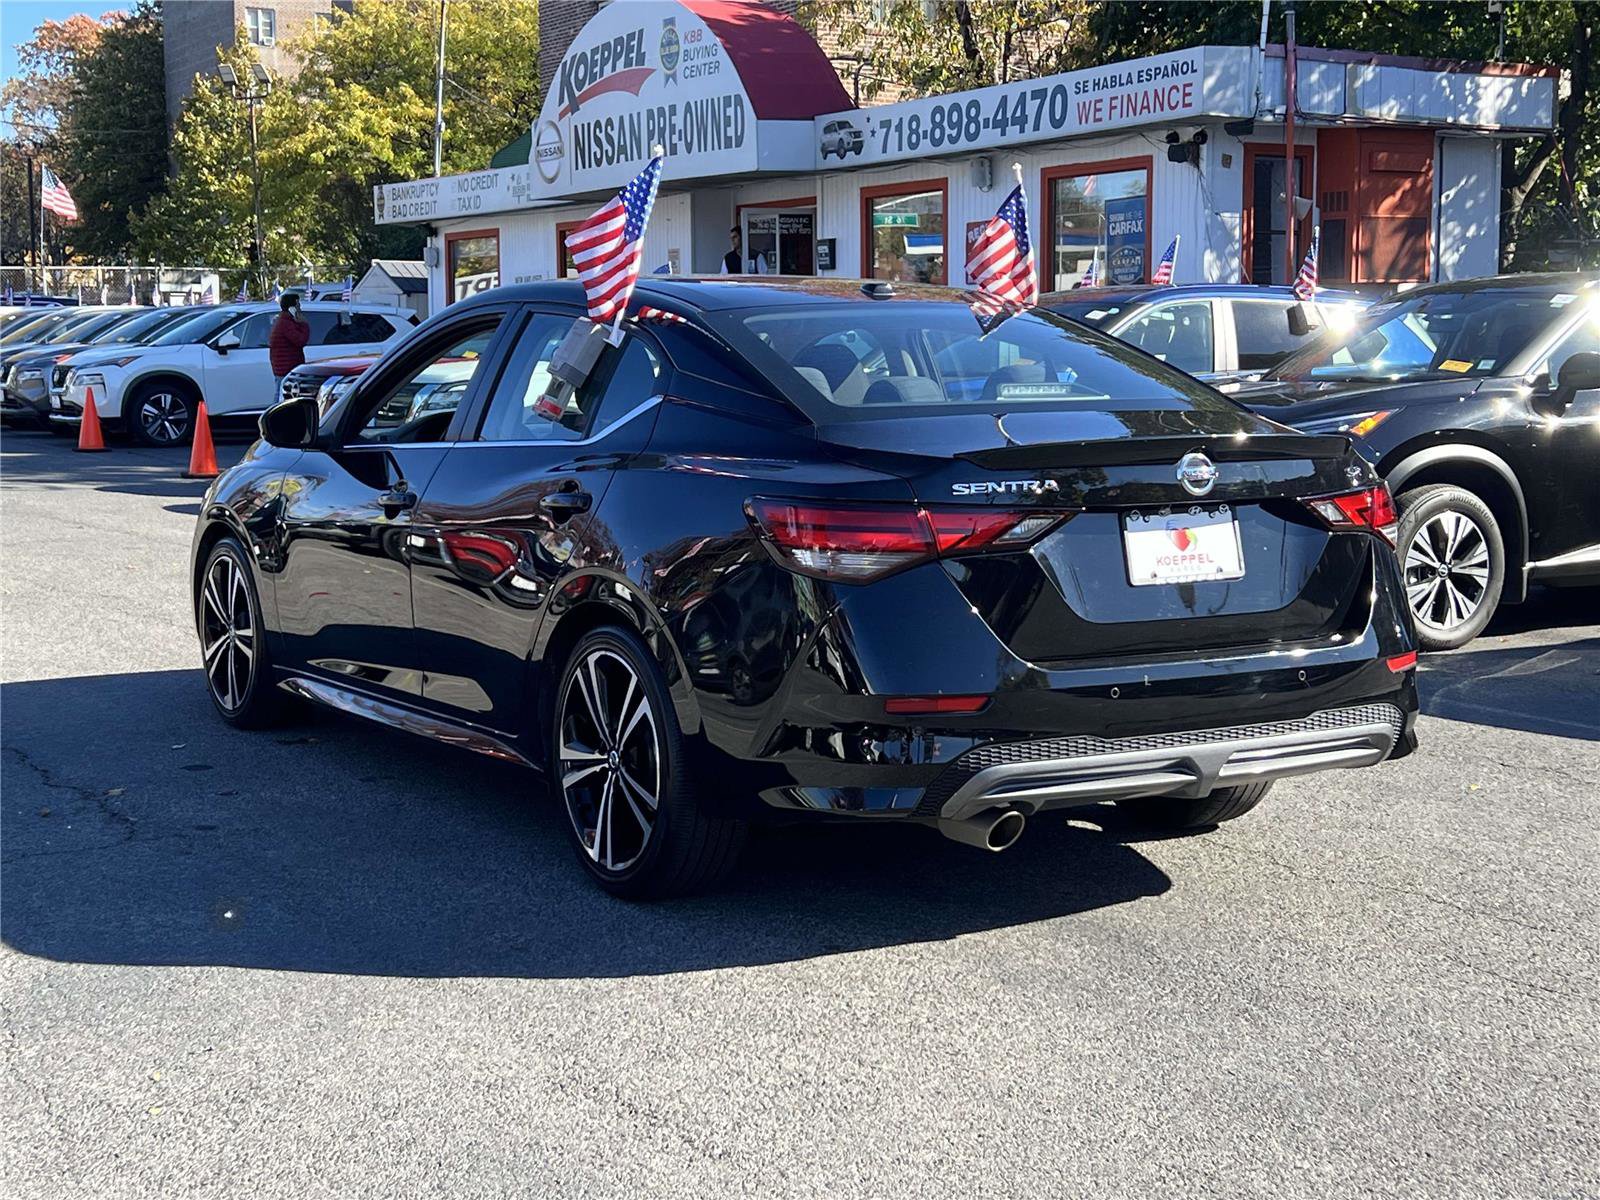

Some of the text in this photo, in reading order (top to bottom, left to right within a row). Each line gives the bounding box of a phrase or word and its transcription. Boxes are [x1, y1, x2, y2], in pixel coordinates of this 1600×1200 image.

[683, 29, 703, 44] KBB
[683, 44, 718, 62] BUYING
[558, 28, 647, 113] KOEPPEL
[683, 60, 720, 79] CENTER
[1074, 59, 1198, 95] SE HABLA ESPAÑOL
[1077, 82, 1193, 125] WE FINANCE
[879, 83, 1068, 154] 718-898-4470
[574, 93, 745, 171] NISSAN PRE-OWNED
[537, 146, 562, 158] NISSAN
[392, 183, 440, 201] BANKRUPTCY
[457, 178, 469, 193] NO
[470, 173, 499, 191] CREDIT
[392, 201, 438, 218] BAD CREDIT
[457, 195, 482, 211] TAX ID
[1109, 220, 1143, 236] CARFAX
[952, 479, 1060, 496] SENTRA
[1156, 553, 1215, 566] KOEPPEL
